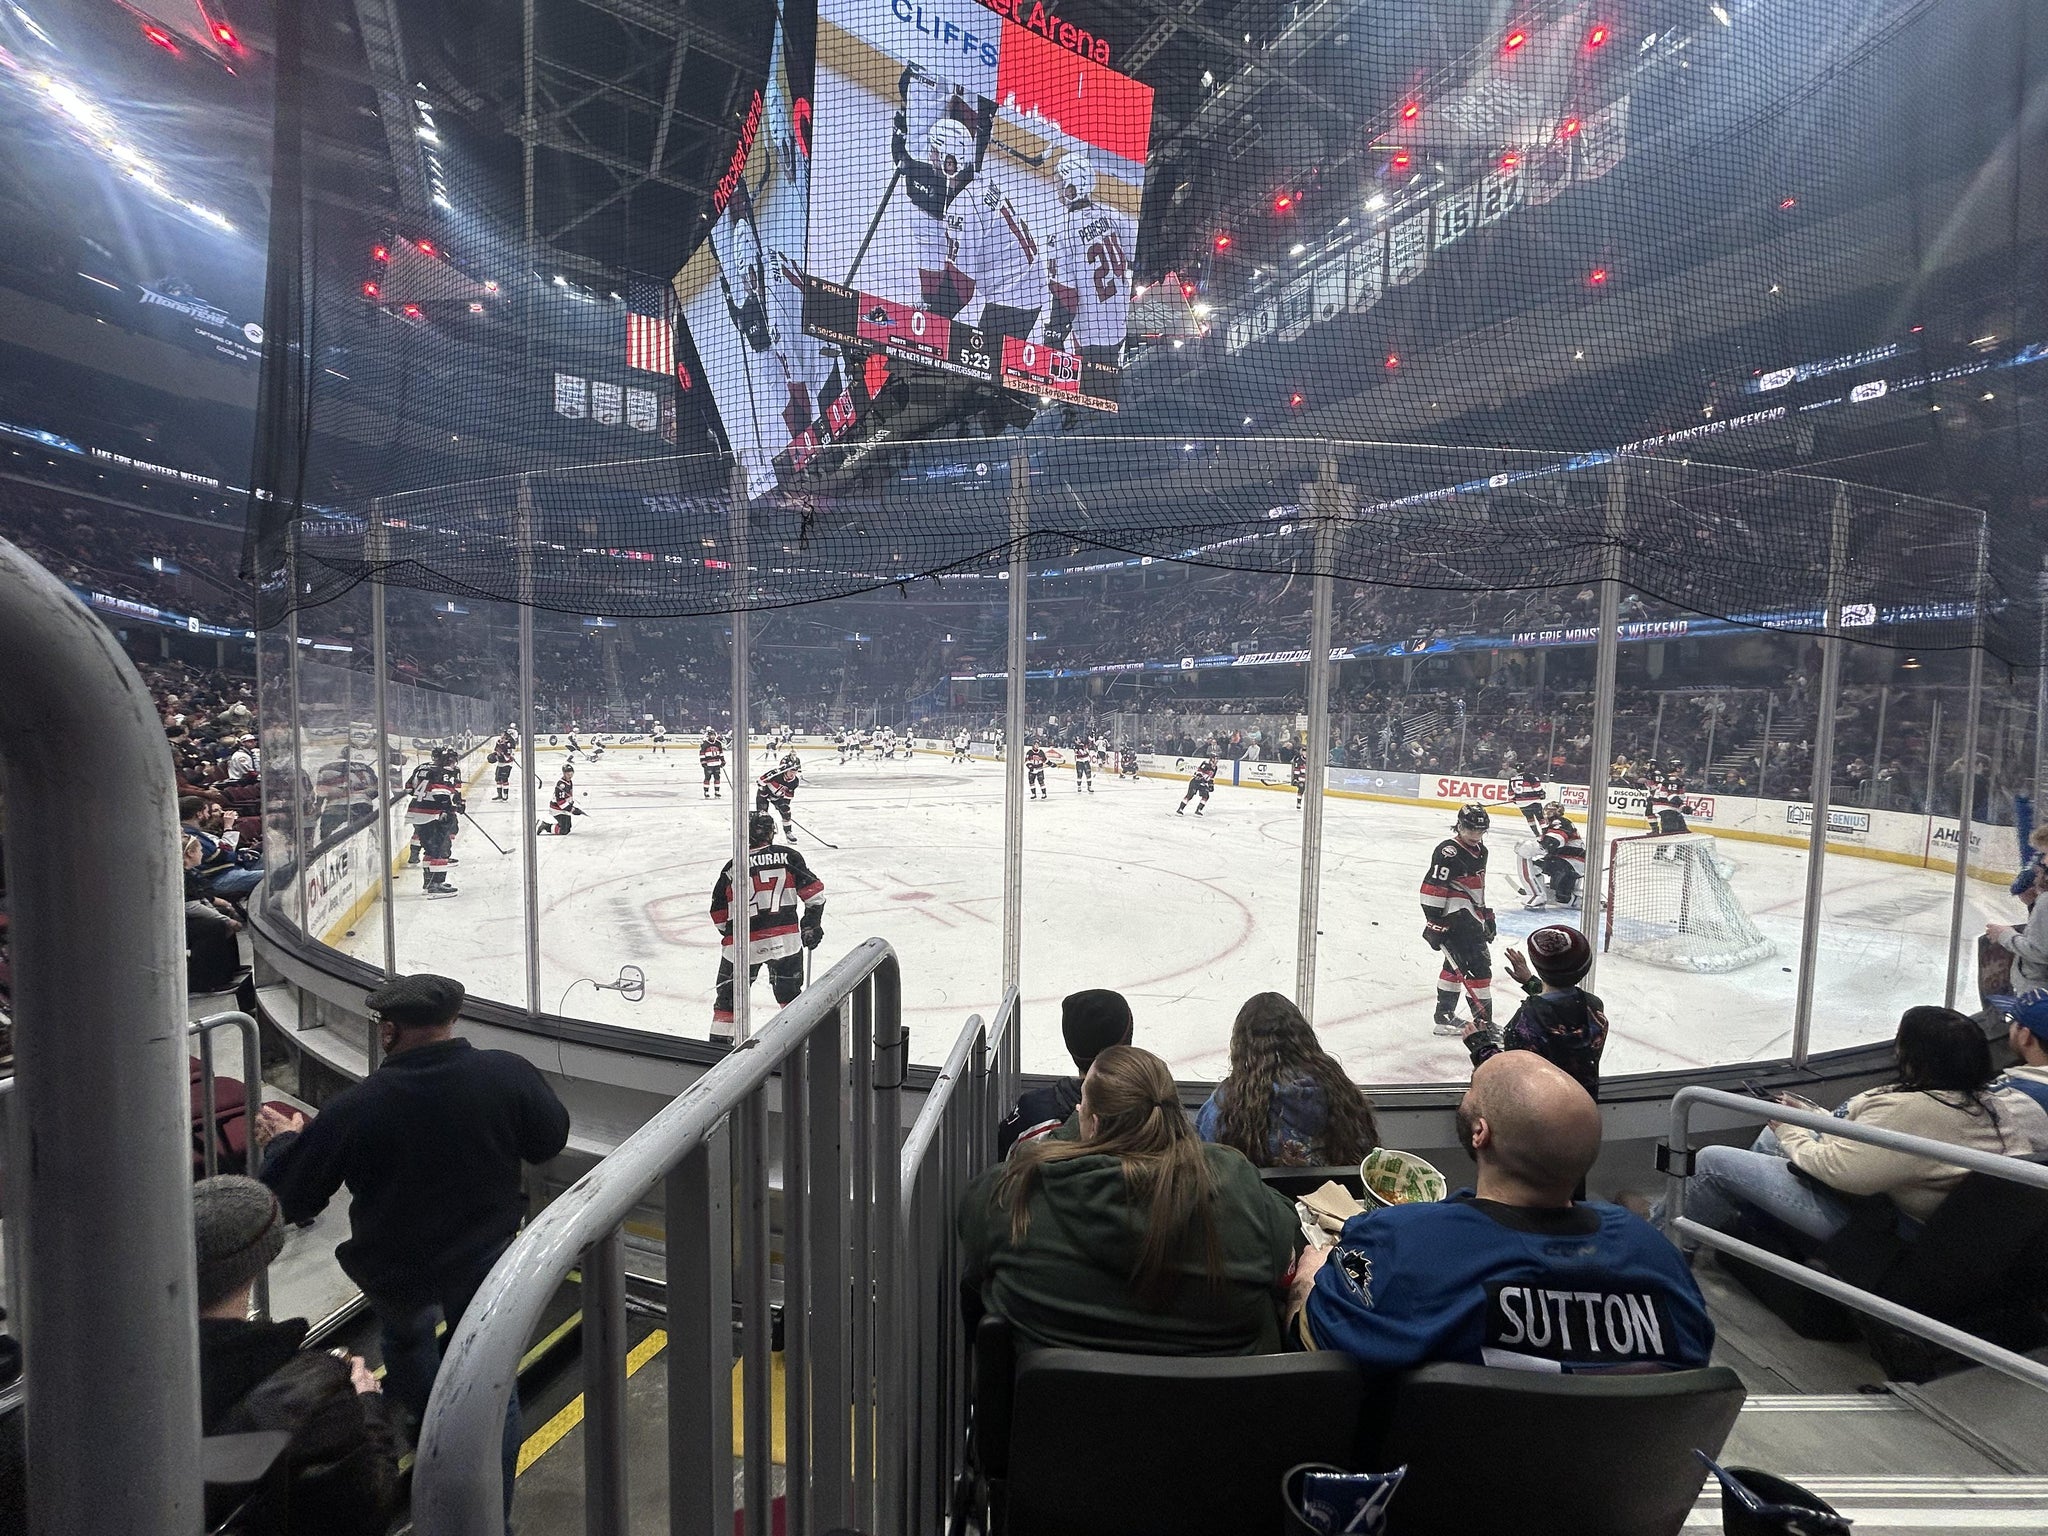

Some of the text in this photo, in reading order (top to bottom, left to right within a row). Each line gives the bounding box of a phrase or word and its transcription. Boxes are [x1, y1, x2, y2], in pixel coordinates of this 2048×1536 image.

[891, 0, 998, 67] CLIFFS
[1027, 0, 1111, 66] Arena
[911, 311, 926, 336] 0
[960, 349, 991, 369] 5:23
[1022, 345, 1036, 366] 0
[1729, 406, 1787, 430] WEEKEND
[1511, 620, 1688, 646] LAKE ERIE MONSS WEEKEND
[443, 773, 455, 785] 24
[1437, 778, 1508, 801] SEATGE
[1562, 786, 1585, 799] drug
[1614, 790, 1648, 799] DISCOUNT
[1563, 798, 1589, 806] mart
[1608, 796, 1627, 809] ug
[1805, 810, 1867, 827] HEGENIUS
[749, 853, 790, 868] KURAK
[1432, 864, 1450, 881] 19
[1499, 1286, 1665, 1356] SUTTON
